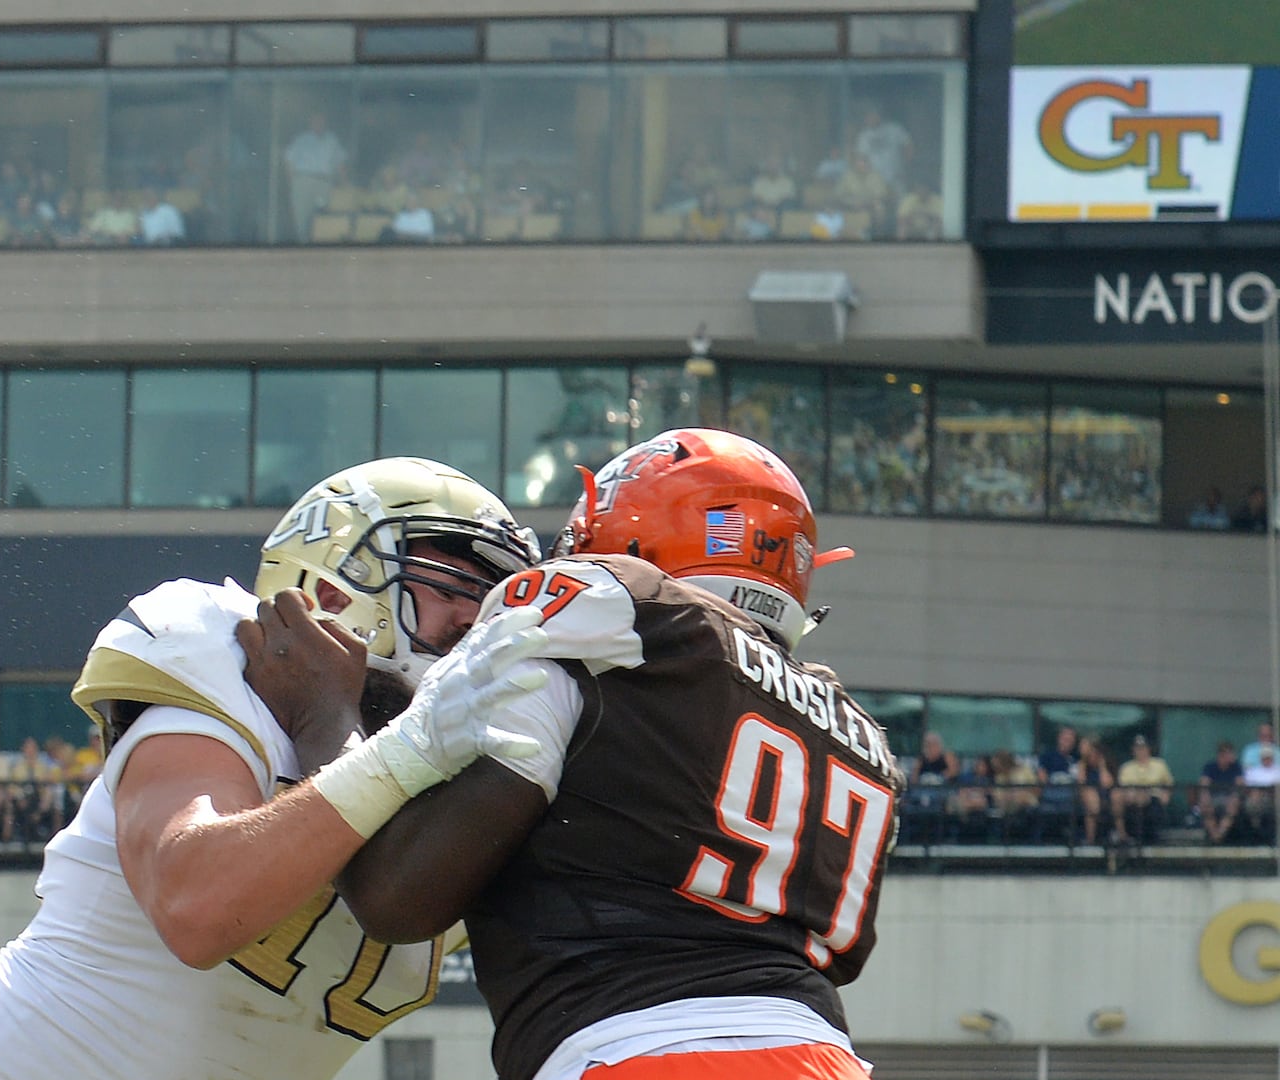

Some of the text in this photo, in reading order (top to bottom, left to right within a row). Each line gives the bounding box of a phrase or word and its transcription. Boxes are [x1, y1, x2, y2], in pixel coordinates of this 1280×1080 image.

[1038, 78, 1221, 191] GT
[1093, 271, 1279, 325] NATIO
[671, 711, 894, 970] 97
